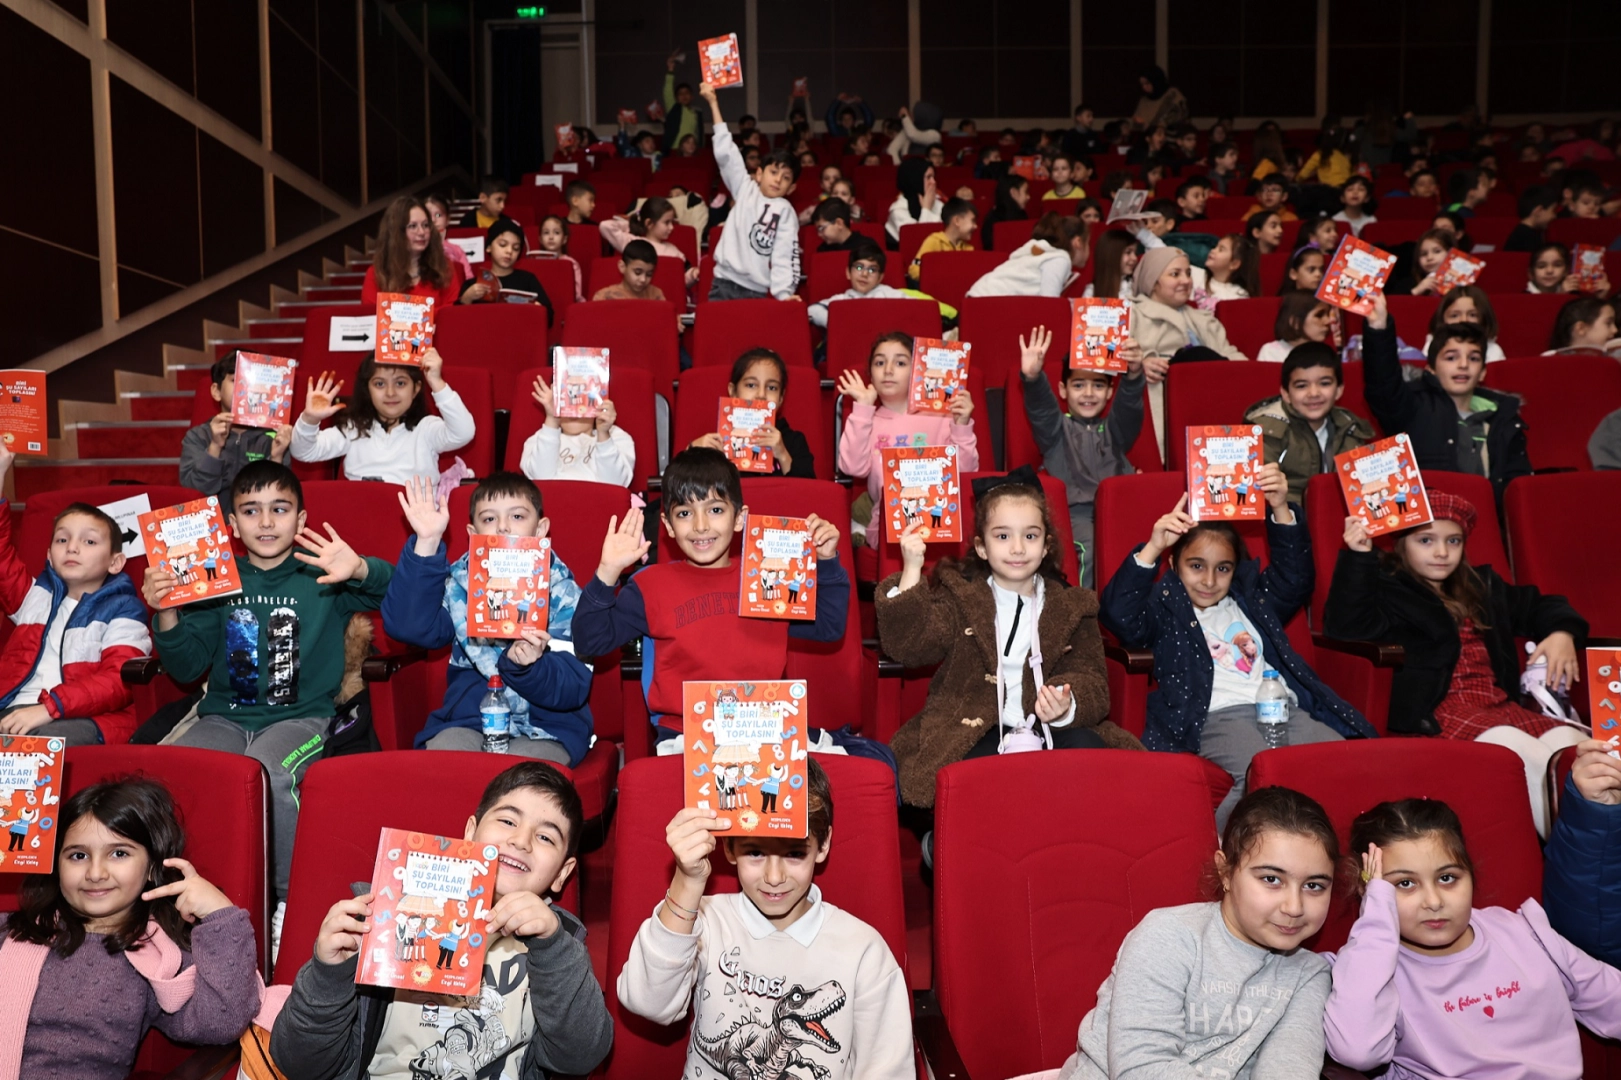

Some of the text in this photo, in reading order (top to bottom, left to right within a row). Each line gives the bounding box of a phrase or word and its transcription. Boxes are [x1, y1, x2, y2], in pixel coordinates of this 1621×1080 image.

[674, 592, 739, 629] BENET
[740, 709, 758, 718] BİRİ
[736, 720, 777, 728] SAYILARI
[726, 730, 775, 738] TOPLASIN!
[432, 862, 449, 873] BİRİ
[425, 872, 466, 886] SAYILARI
[415, 880, 463, 894] TOPLASIN!
[1200, 980, 1242, 995] VARSIT
[1444, 1001, 1455, 1013] the
[1458, 996, 1481, 1012] future
[1496, 981, 1521, 999] bright
